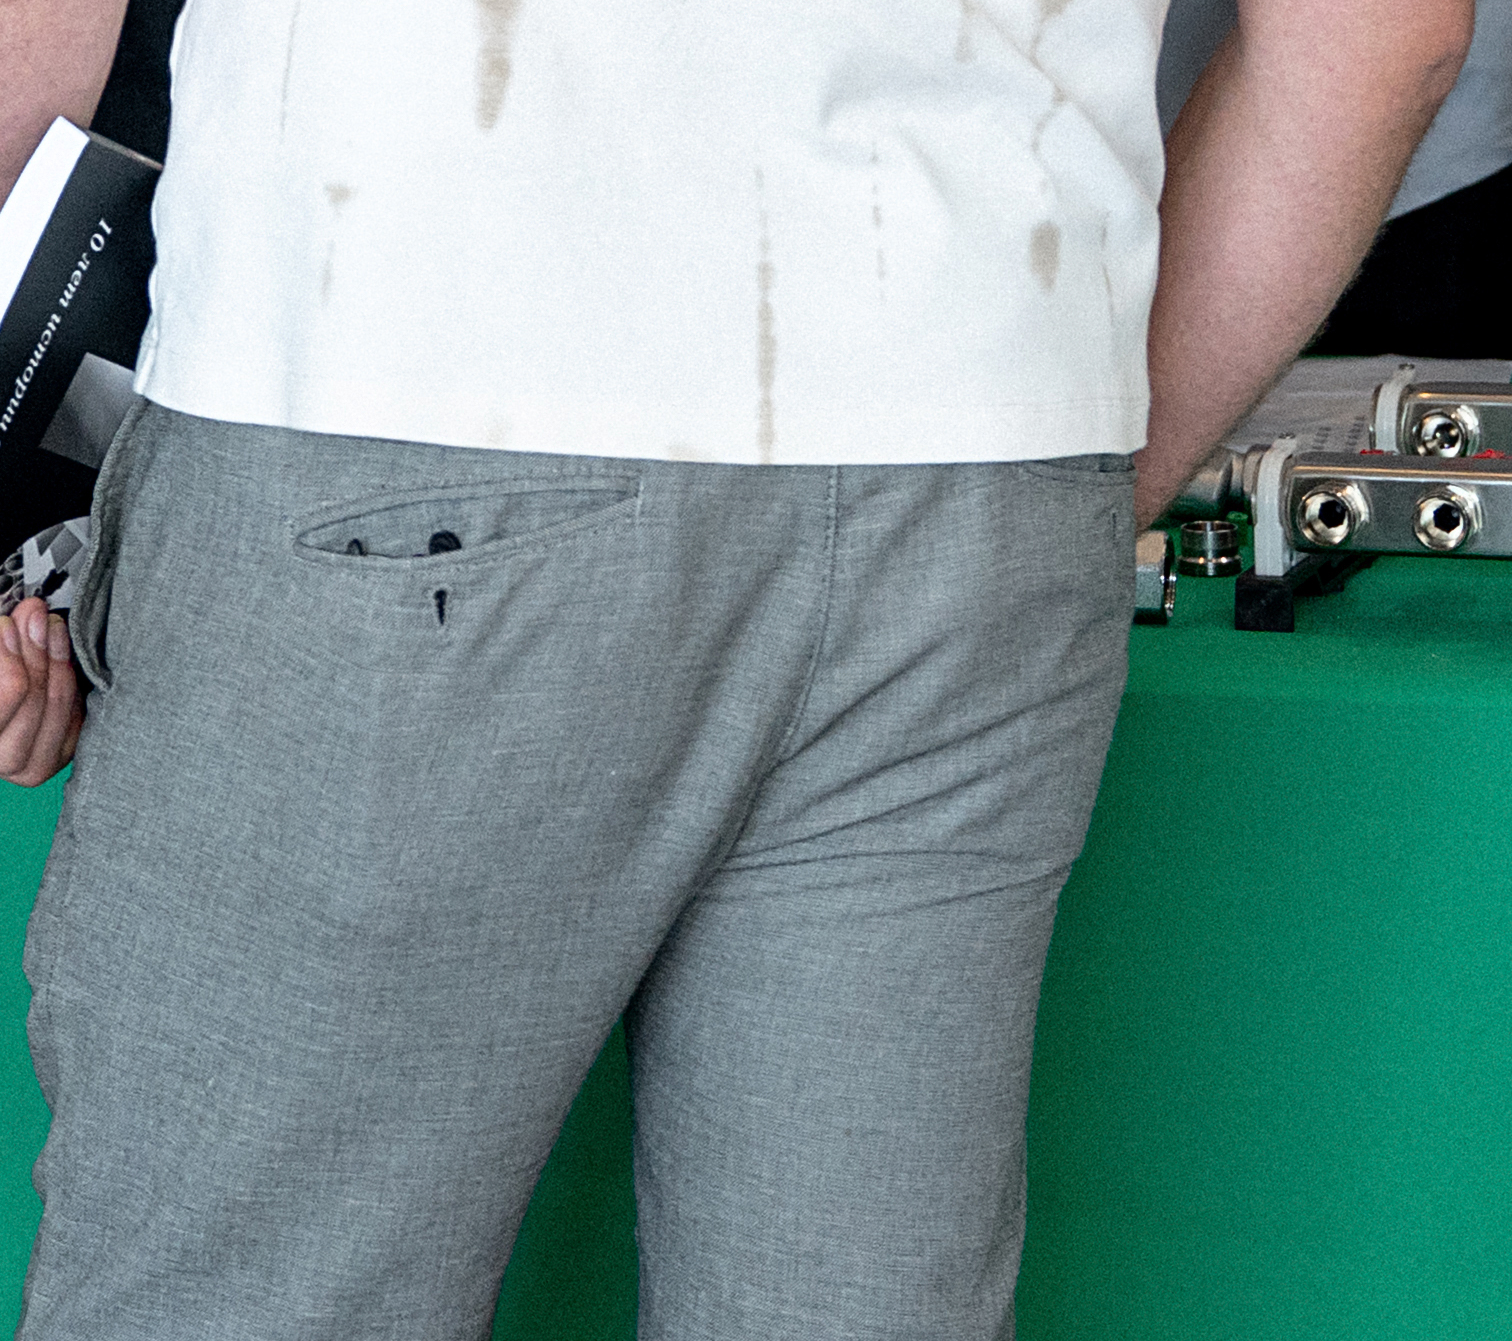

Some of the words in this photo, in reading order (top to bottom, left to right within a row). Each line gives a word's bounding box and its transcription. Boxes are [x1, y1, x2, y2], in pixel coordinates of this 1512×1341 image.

[90, 218, 112, 252] 10
[59, 252, 91, 308] лет
[0, 313, 61, 432] истории
